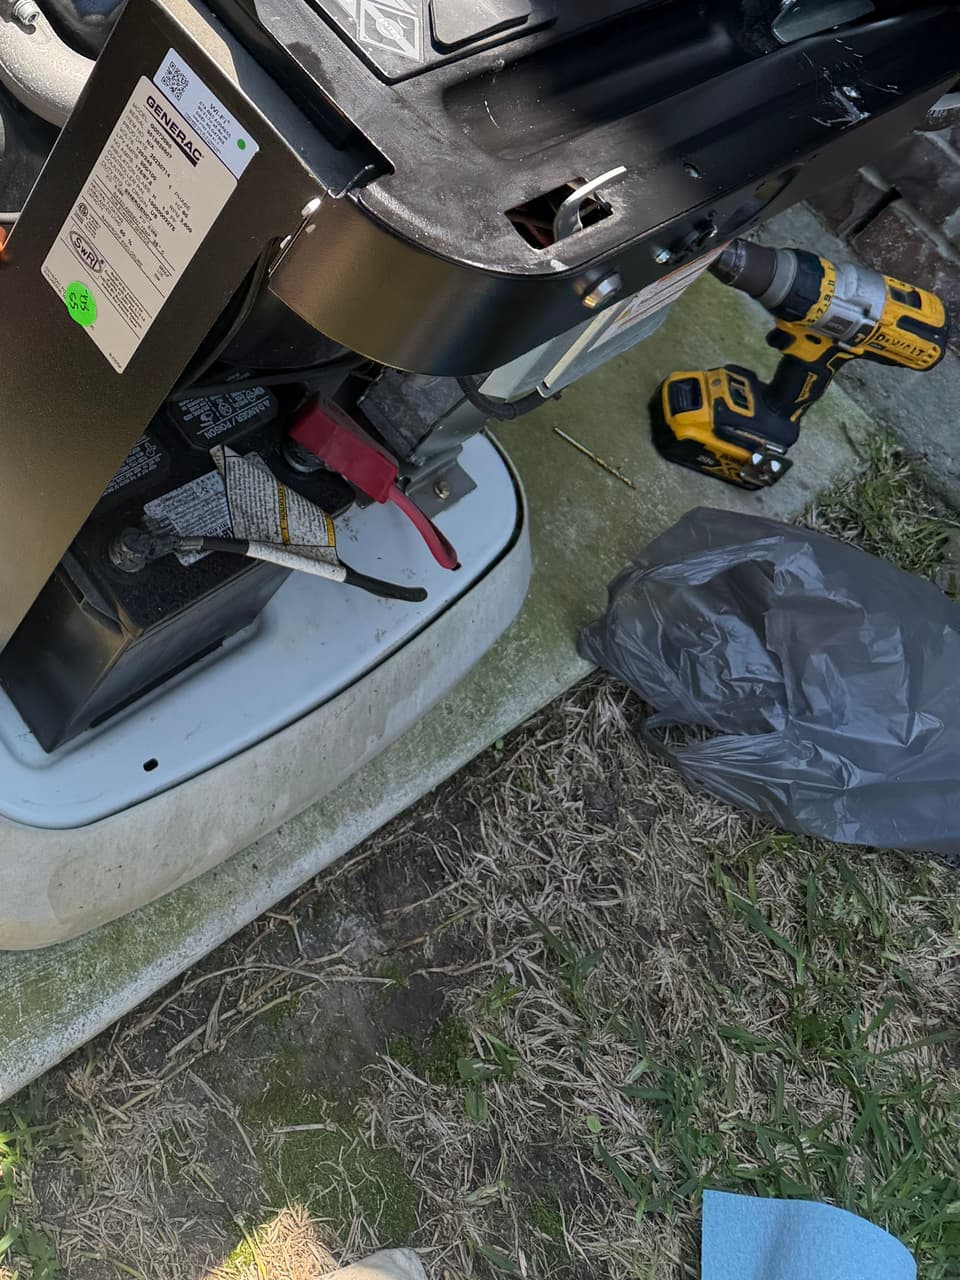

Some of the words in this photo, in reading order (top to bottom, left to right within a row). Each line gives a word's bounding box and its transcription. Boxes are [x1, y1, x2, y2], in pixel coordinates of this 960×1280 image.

[145, 93, 202, 163] GENERAC
[72, 235, 97, 270] SwRI
[873, 332, 926, 358] DEWALT
[234, 402, 265, 423] DANGER
[203, 419, 232, 439] POISON
